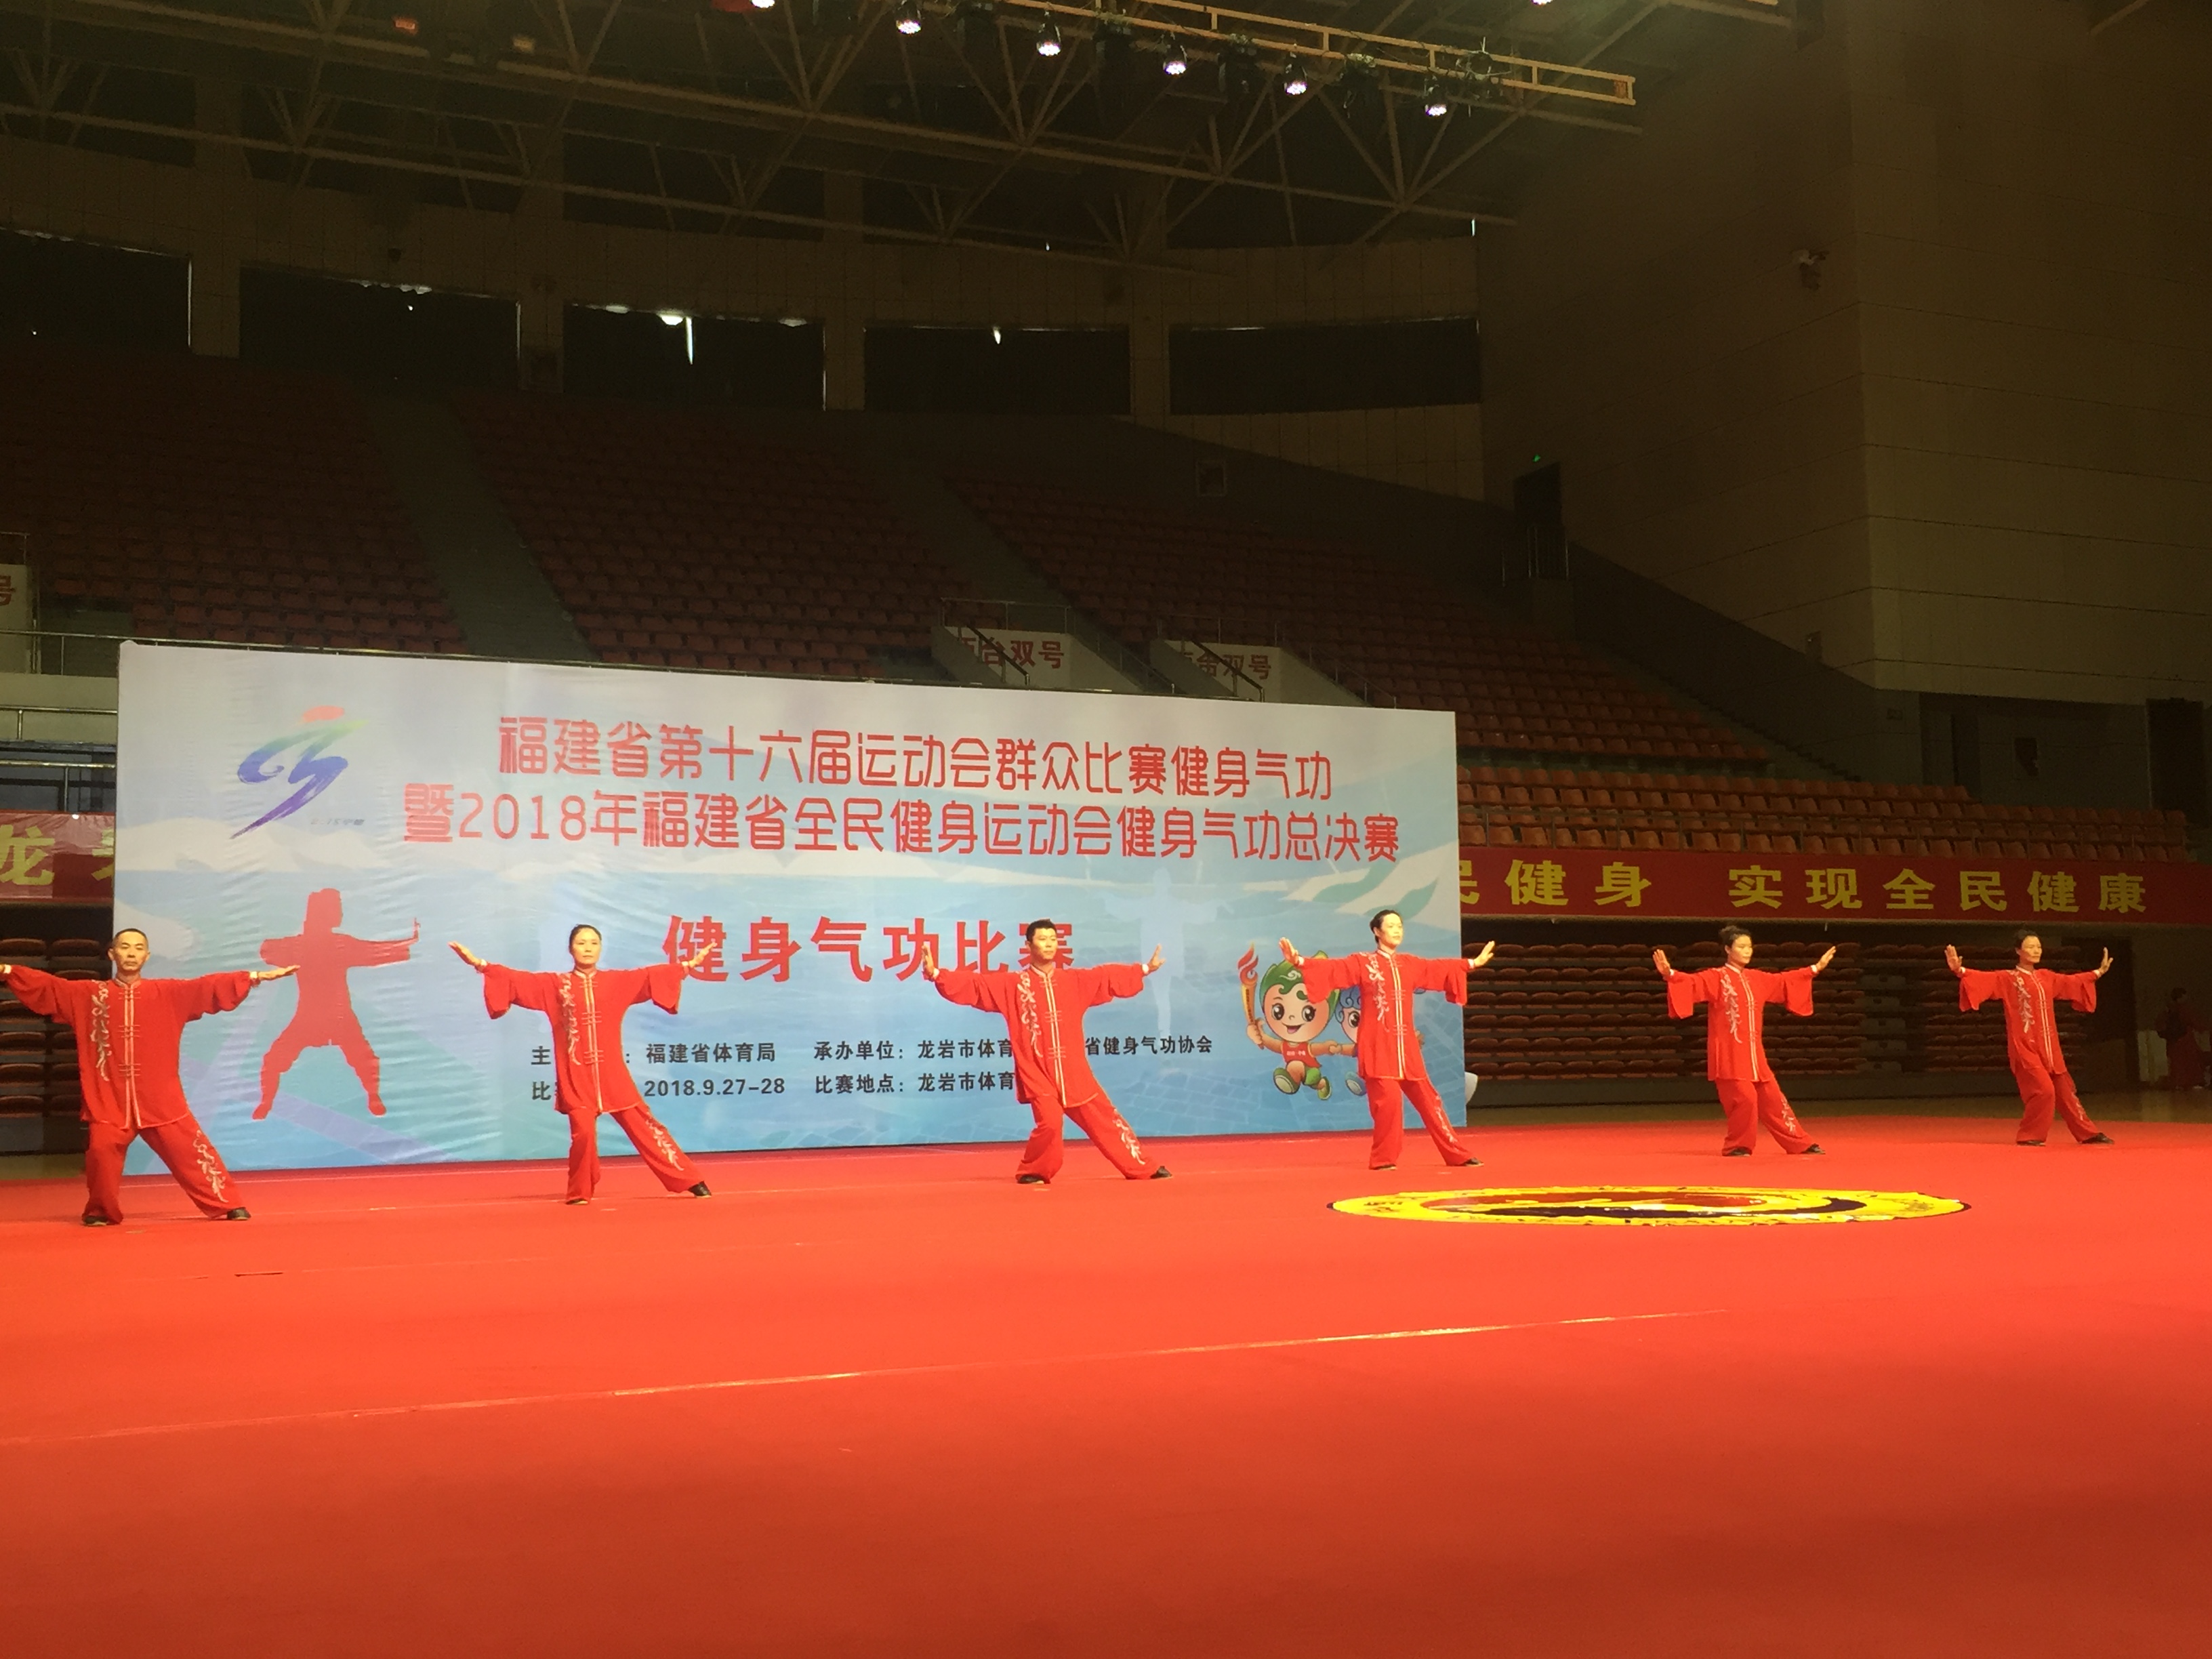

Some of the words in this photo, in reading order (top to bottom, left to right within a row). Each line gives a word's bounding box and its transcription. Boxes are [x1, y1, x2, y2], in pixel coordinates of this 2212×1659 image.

[499, 717, 1331, 800] 福建省第十六届运动会群众比赛健身气功
[404, 783, 1399, 862] 暨2018年福建省全民健身运动会健身气功总决赛
[1729, 865, 2146, 913] 实现全民健康
